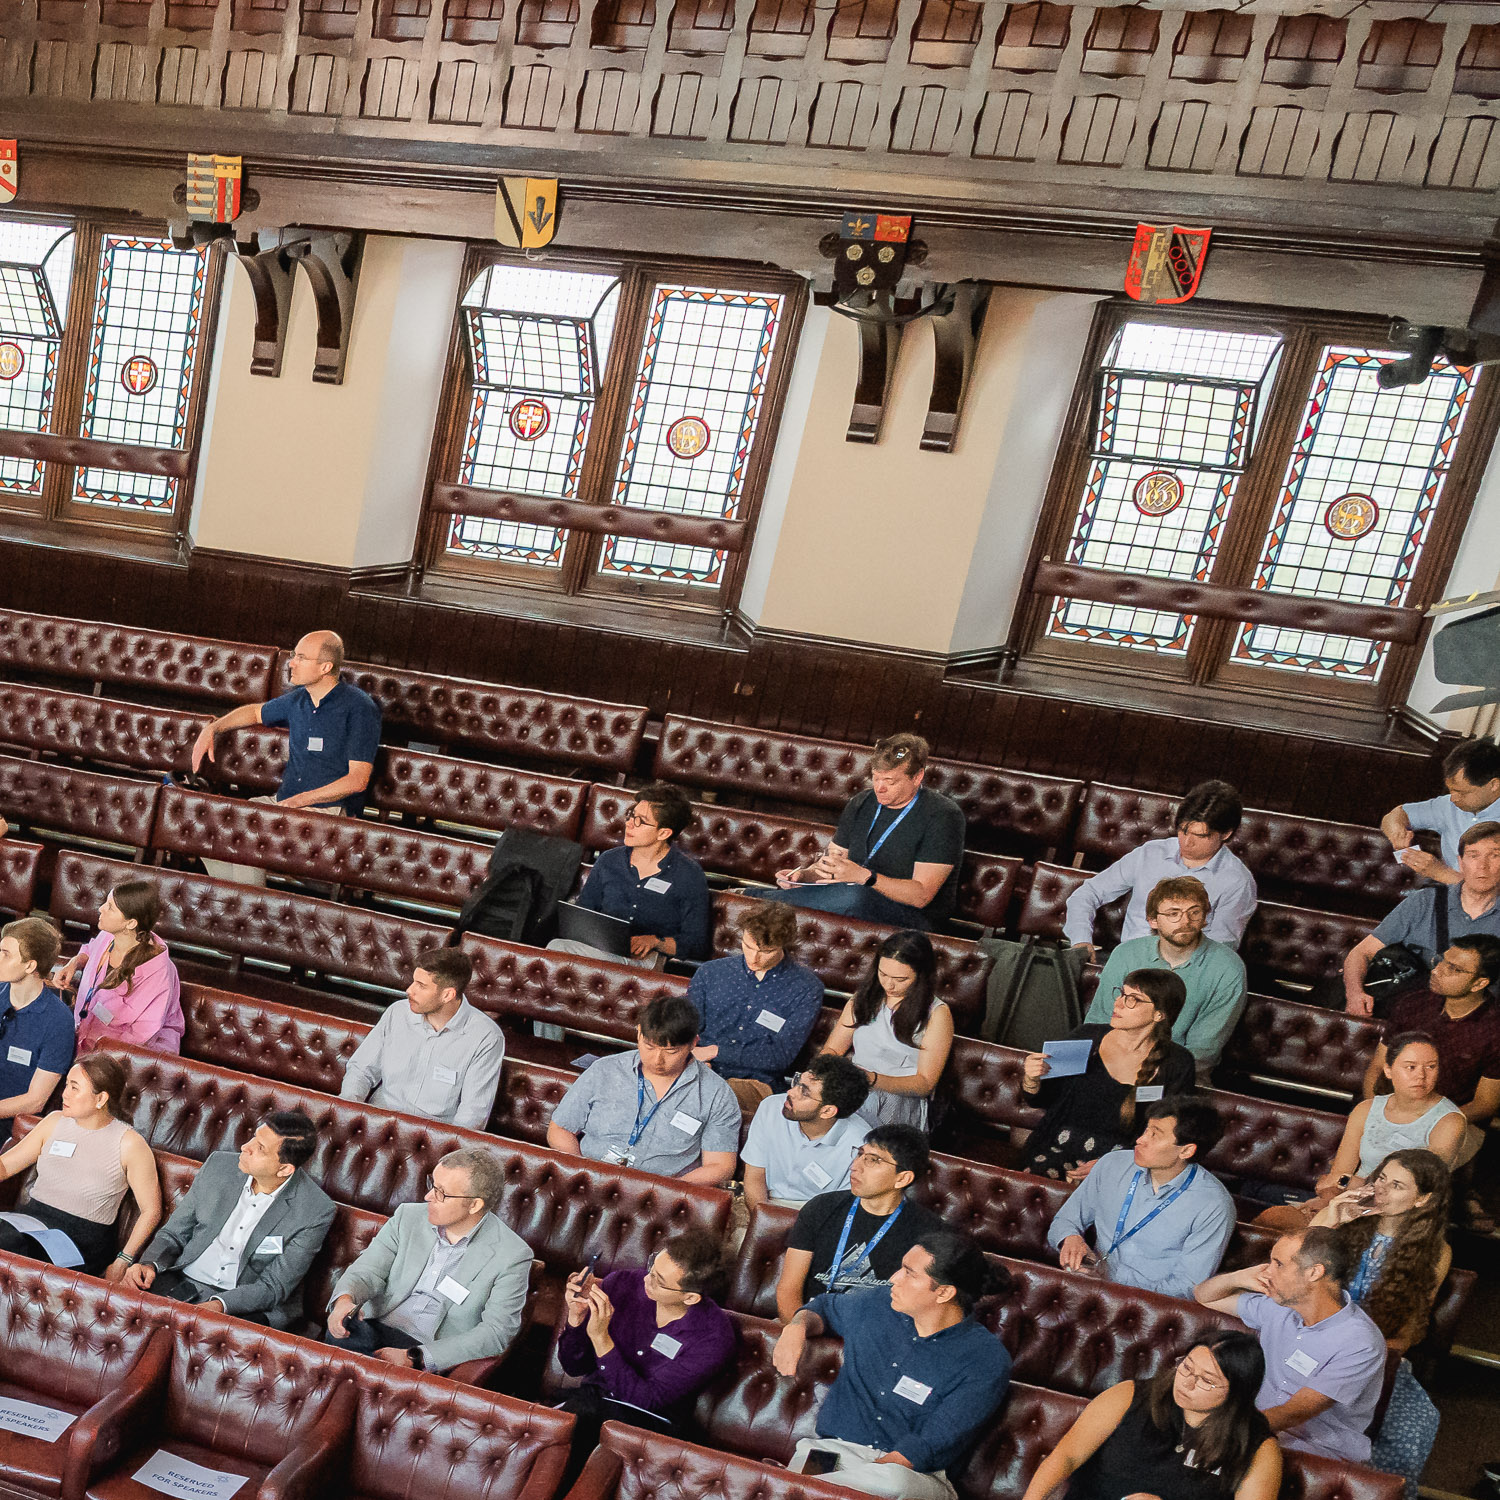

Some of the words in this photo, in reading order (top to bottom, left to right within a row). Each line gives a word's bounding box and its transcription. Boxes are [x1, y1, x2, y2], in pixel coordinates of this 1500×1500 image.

[0, 1408, 46, 1424] RESERVED
[4, 1417, 50, 1432] SPEAKERS
[151, 1473, 171, 1486] FOR
[171, 1479, 219, 1497] SPEAKERS
[167, 1470, 215, 1489] RESERVED
